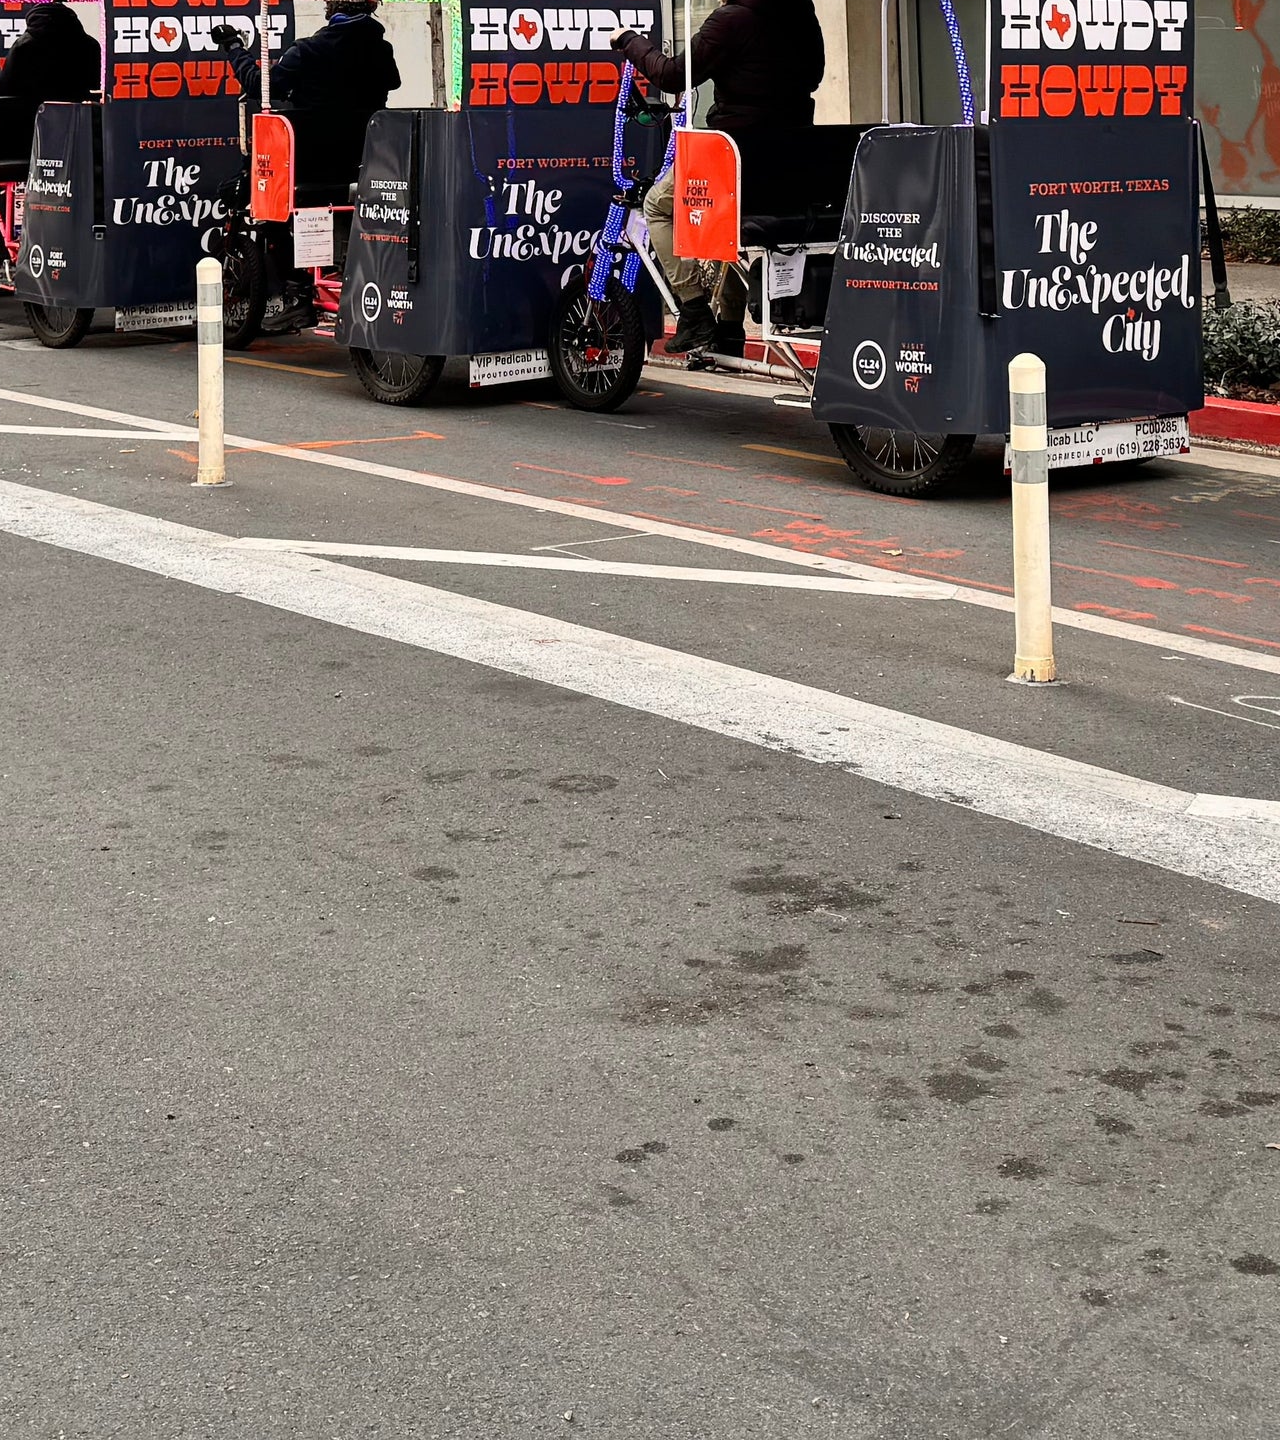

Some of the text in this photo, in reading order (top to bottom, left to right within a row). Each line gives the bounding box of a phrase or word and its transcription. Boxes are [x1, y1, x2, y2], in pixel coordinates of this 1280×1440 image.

[469, 7, 654, 51] HOWDY
[112, 60, 242, 100] HOW
[1000, 64, 1188, 118] HOWDY
[138, 139, 173, 150] FORT
[497, 155, 636, 170] FORT WORTH, TEAS
[143, 156, 201, 196] The
[370, 179, 408, 190] DISCOVER
[686, 186, 709, 197] FORT
[1029, 182, 1068, 197] FORT
[1125, 179, 1170, 193] TEXAS
[380, 192, 397, 201] THE
[502, 178, 563, 225] The
[682, 197, 714, 208] WORTH
[112, 192, 229, 227] UnExpe
[359, 203, 410, 226] UnExpecte
[860, 213, 921, 224] DISCOVER
[359, 233, 409, 244] FORTWORTH.C
[877, 227, 902, 239] THE
[1034, 208, 1098, 265] The
[468, 225, 606, 264] UnExpe
[843, 242, 941, 269] UnExpected
[845, 278, 939, 291] FORTWORTH.COM
[1002, 254, 1195, 314] UnExpected
[390, 291, 409, 300] FORT
[386, 299, 413, 310] WORTH
[1102, 307, 1162, 361] City
[476, 350, 548, 369] VIP Pedicab LL
[900, 350, 925, 362] FORT
[858, 359, 880, 371] CL24
[895, 362, 933, 375] WORTH
[1047, 421, 1178, 447] icab LLC PC00285
[1116, 442, 1141, 457] (619)
